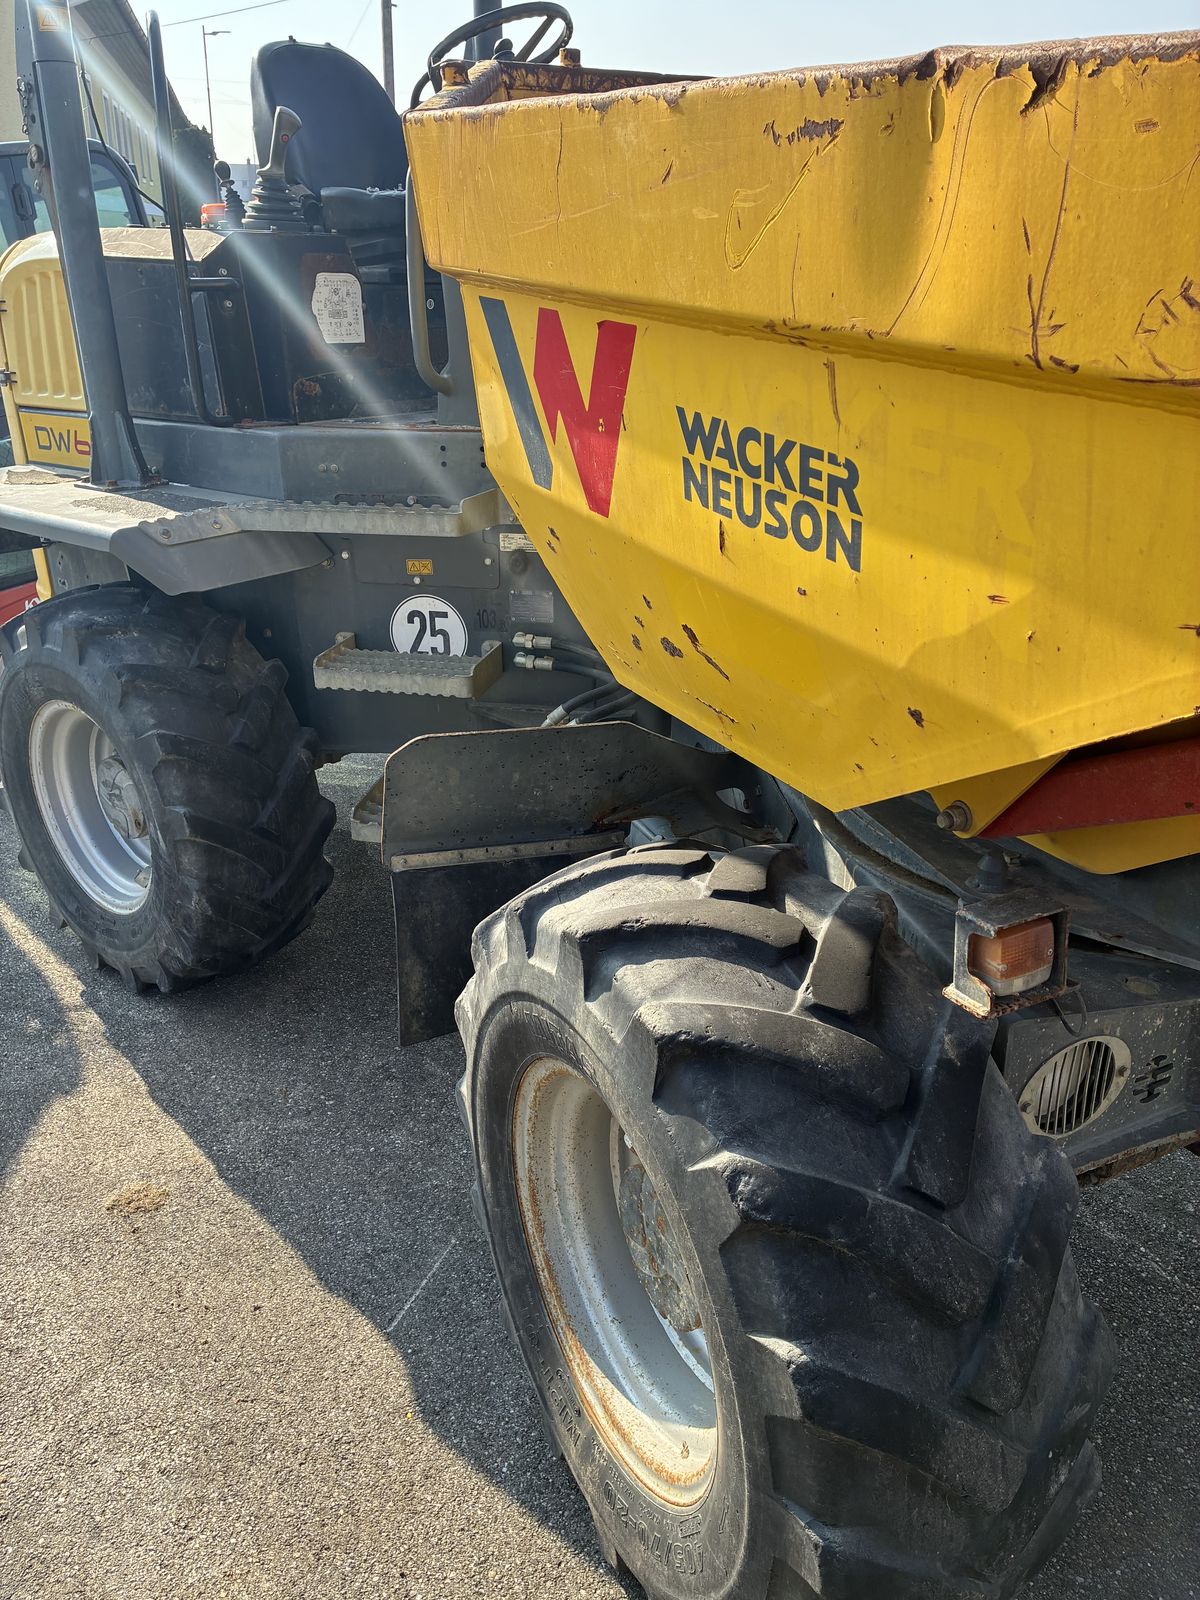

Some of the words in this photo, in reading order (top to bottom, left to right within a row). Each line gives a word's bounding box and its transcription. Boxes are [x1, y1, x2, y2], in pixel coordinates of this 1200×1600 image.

[676, 405, 863, 517] WACKER
[682, 456, 862, 573] NEUSON
[407, 610, 450, 656] 25
